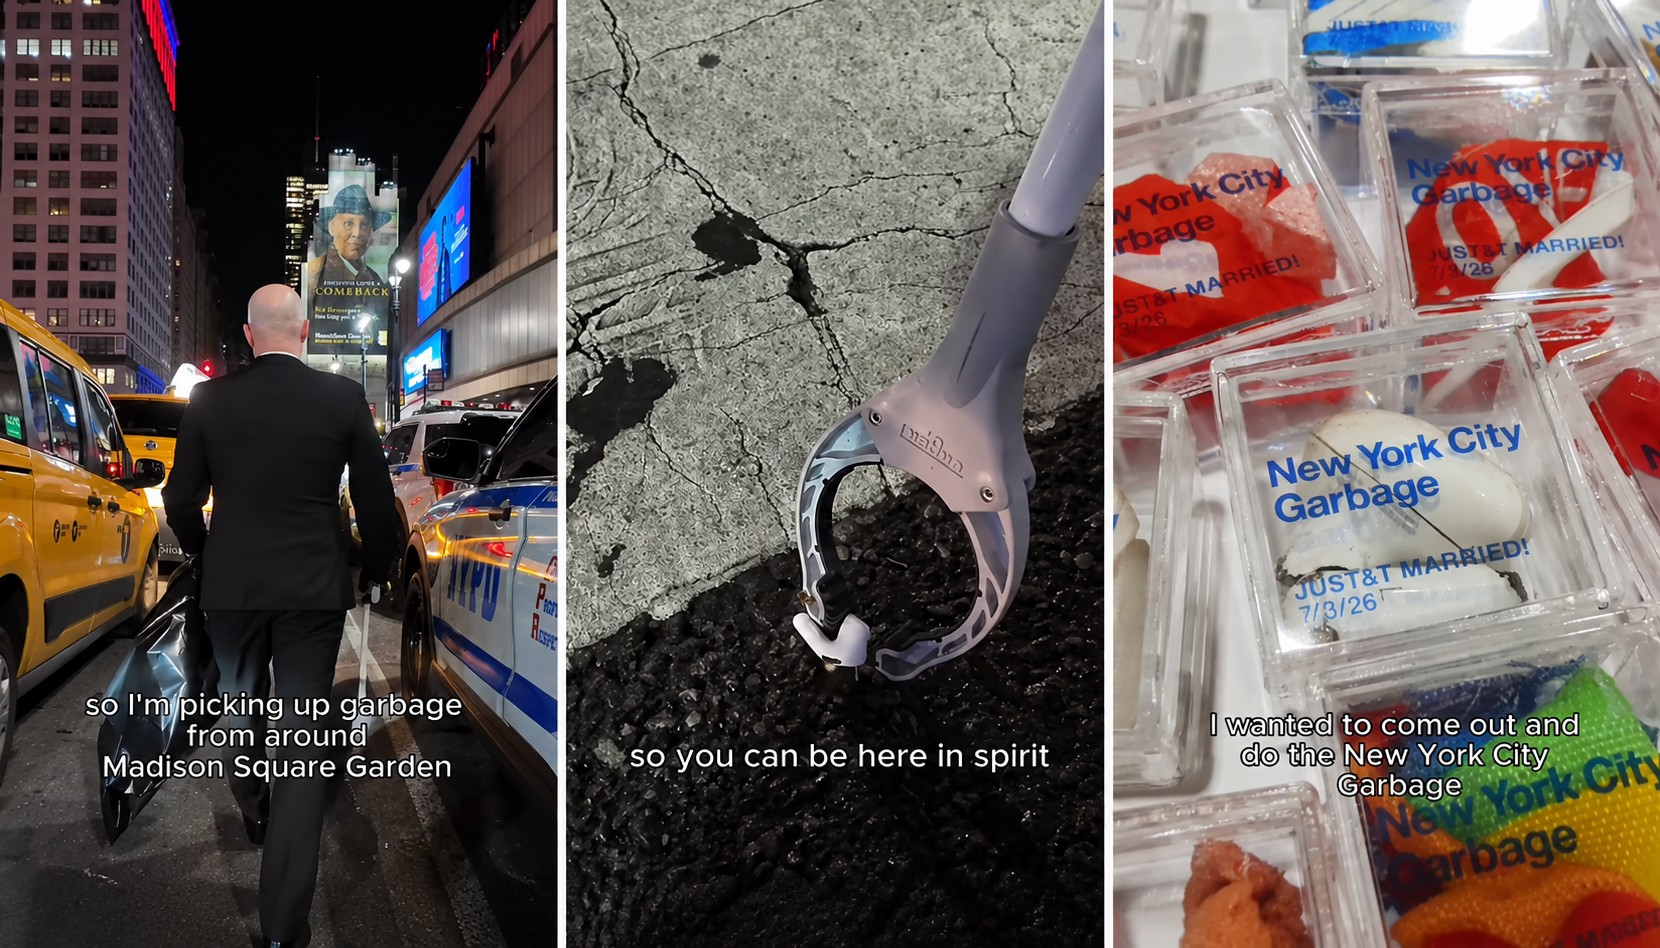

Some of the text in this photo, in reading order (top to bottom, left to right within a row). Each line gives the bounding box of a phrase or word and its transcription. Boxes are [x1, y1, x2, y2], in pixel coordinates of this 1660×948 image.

[1406, 149, 1624, 180] New York City
[1136, 182, 1216, 216] York
[1218, 168, 1283, 195] City
[1411, 181, 1551, 206] Garbage
[1112, 215, 1215, 257] rbage
[1428, 235, 1625, 261] JUST&T MARRIED!
[315, 287, 389, 296] COMEBACK
[1185, 254, 1300, 298] MARRIED!
[1430, 262, 1494, 280] 7/3/26
[1267, 424, 1520, 488] New York City
[1274, 476, 1440, 523] Garbage
[1294, 538, 1530, 601] JUST&T MARRIED!
[1299, 593, 1377, 624] 7/3/26
[1376, 796, 1474, 841] New
[1480, 766, 1580, 816] York
[1387, 825, 1578, 892] Garbage
